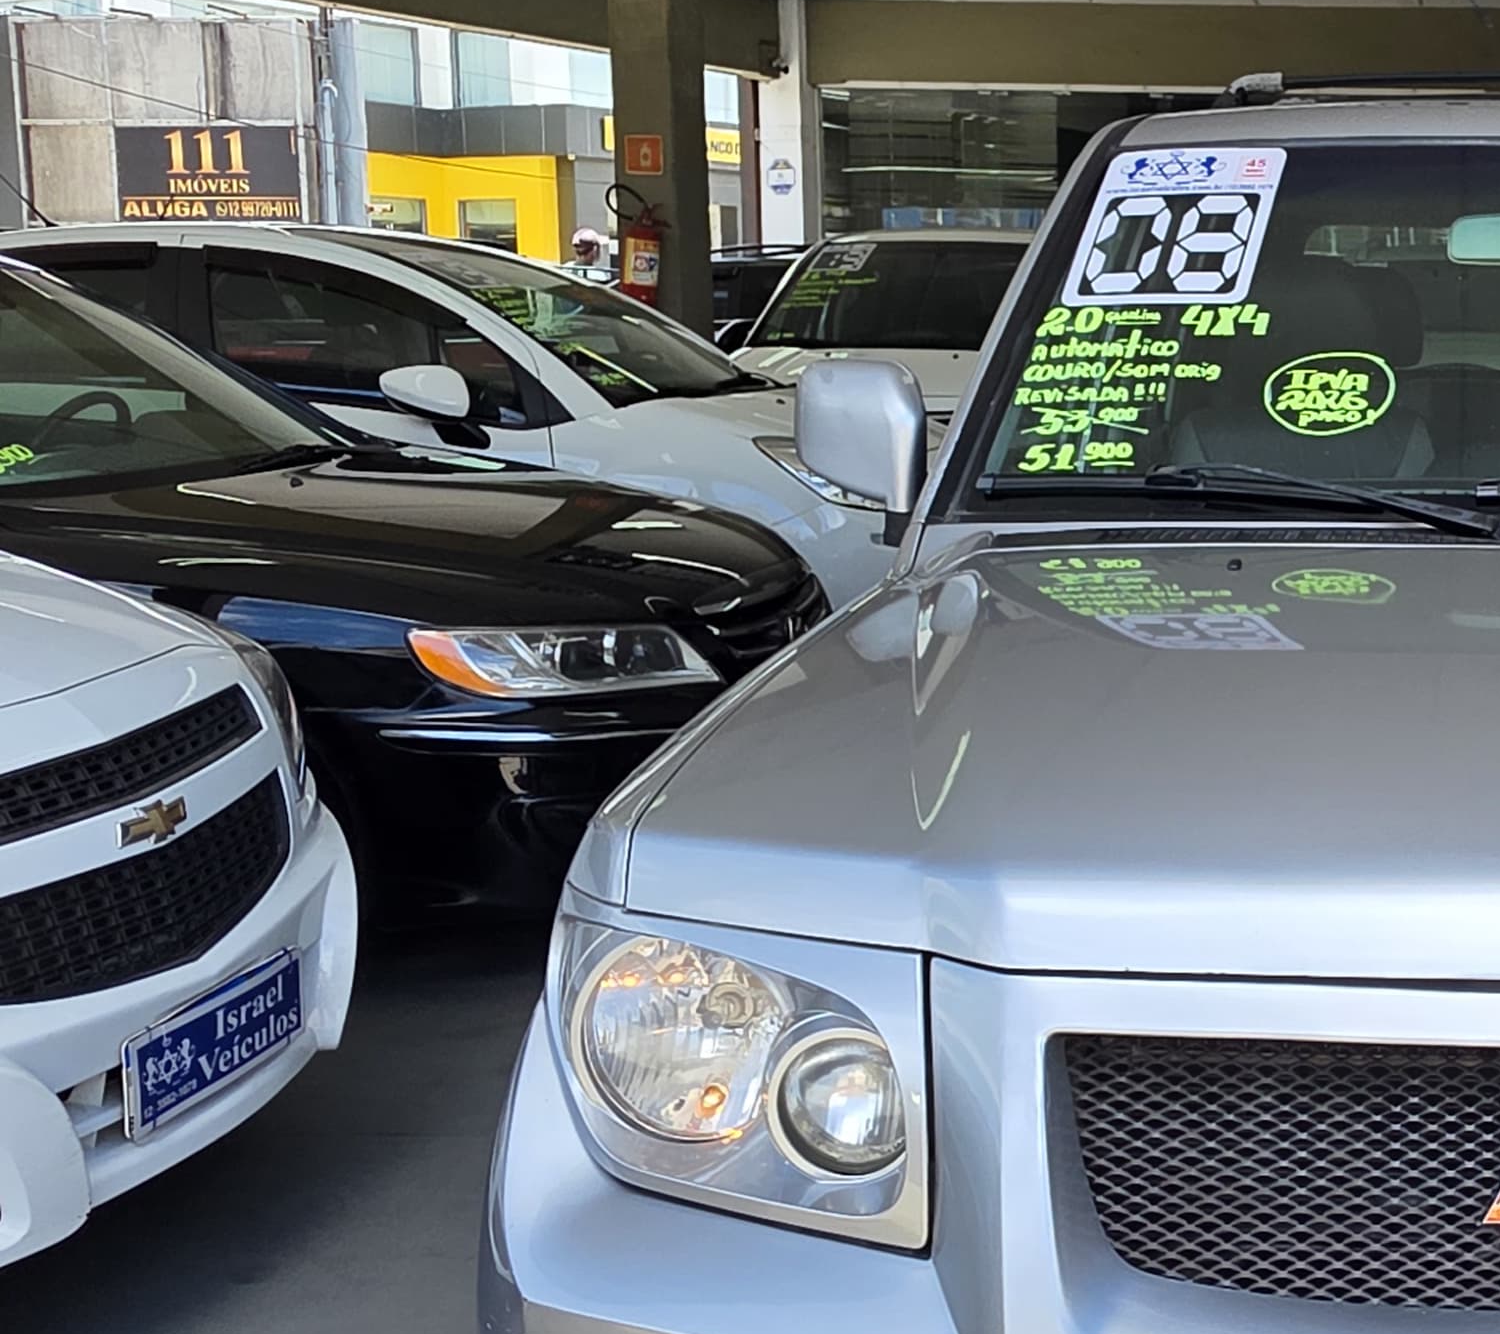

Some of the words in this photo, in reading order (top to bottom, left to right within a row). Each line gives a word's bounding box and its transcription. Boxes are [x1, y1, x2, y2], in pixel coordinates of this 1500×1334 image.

[163, 129, 250, 174] 111
[169, 175, 250, 194] IMÓVEIS
[123, 200, 208, 218] ALUGA
[1085, 195, 1255, 294] 08
[1036, 306, 1105, 338] 2.0
[1282, 368, 1370, 392] IPVA
[1275, 389, 1369, 410] 2026
[214, 973, 284, 1042] Israel
[198, 1006, 299, 1082] Veículos
